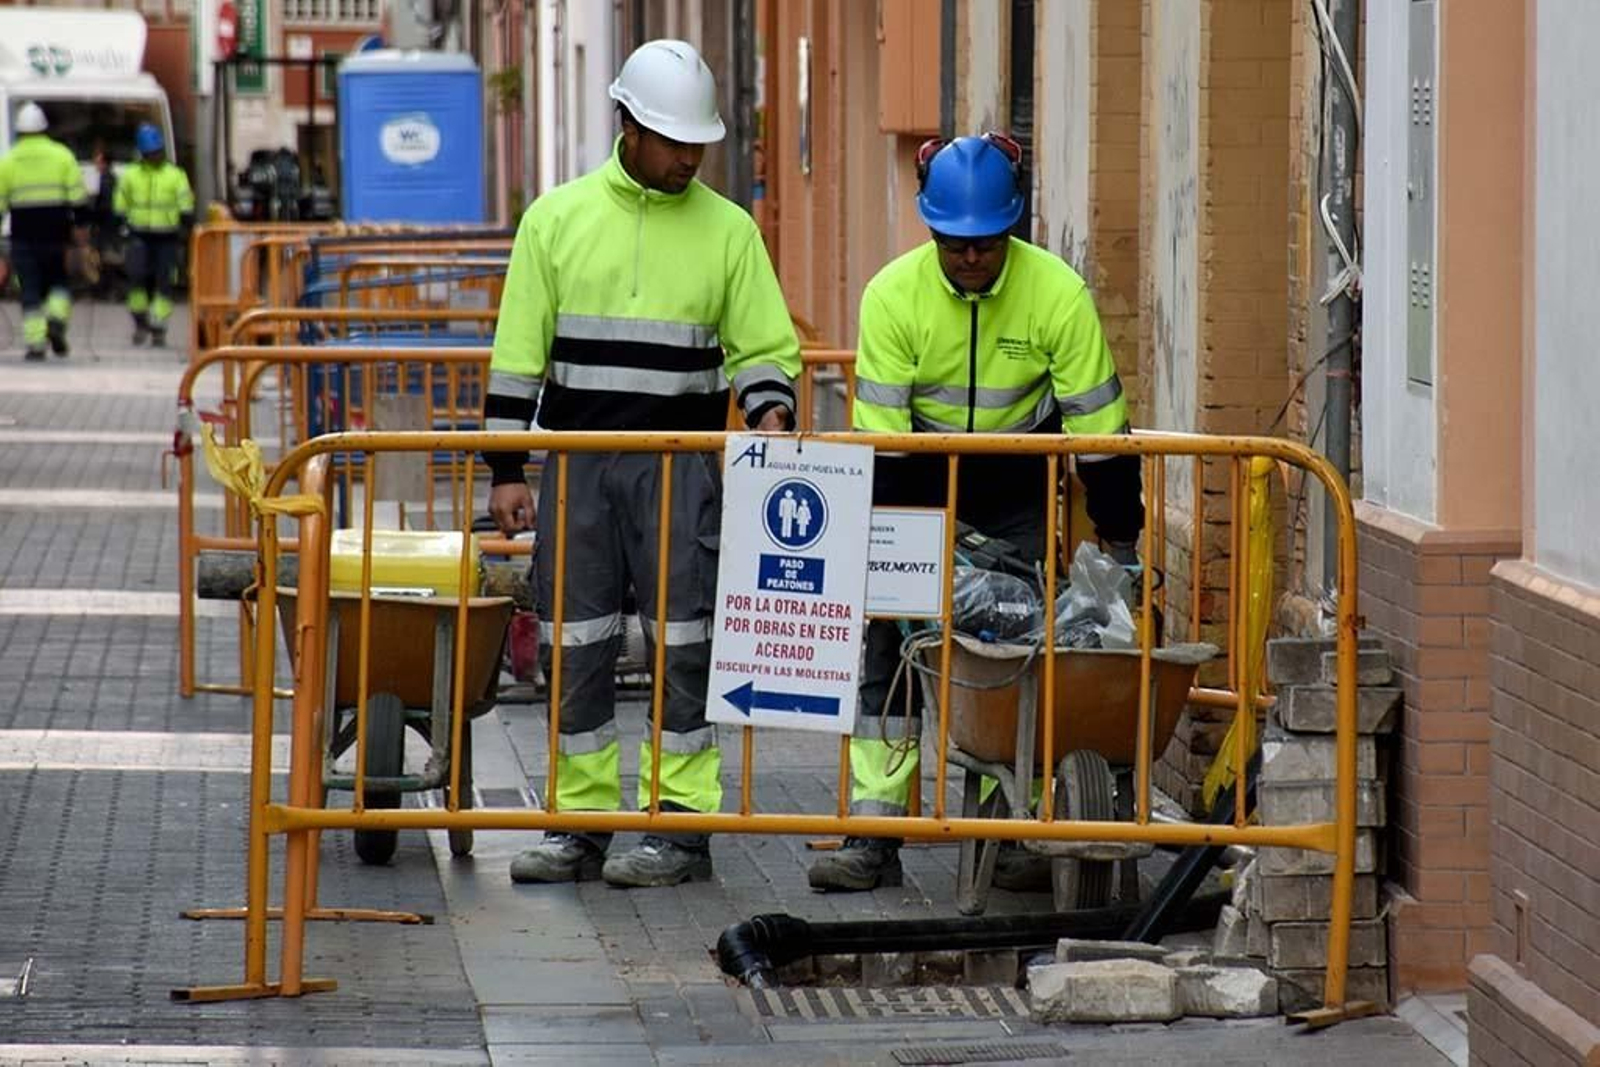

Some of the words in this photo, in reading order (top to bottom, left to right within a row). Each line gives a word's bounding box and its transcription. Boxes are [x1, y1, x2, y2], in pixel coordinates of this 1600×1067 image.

[767, 461, 797, 471] AGUAS
[798, 463, 810, 472] DE
[779, 558, 805, 570] PASO
[785, 569, 798, 579] DE
[766, 577, 815, 592] PEATONES
[725, 594, 752, 612] POR
[755, 597, 771, 613] LA
[774, 598, 807, 615] OTRA
[810, 602, 852, 620] ACERA
[724, 616, 750, 633] POR
[754, 619, 796, 637] OBRAS
[799, 623, 816, 638] EN
[820, 625, 850, 642] ESTE
[755, 642, 815, 661] ACERADO
[715, 661, 771, 675] DISCULPEN
[774, 666, 793, 677] LAS
[795, 668, 851, 681] MOLESTIAS
